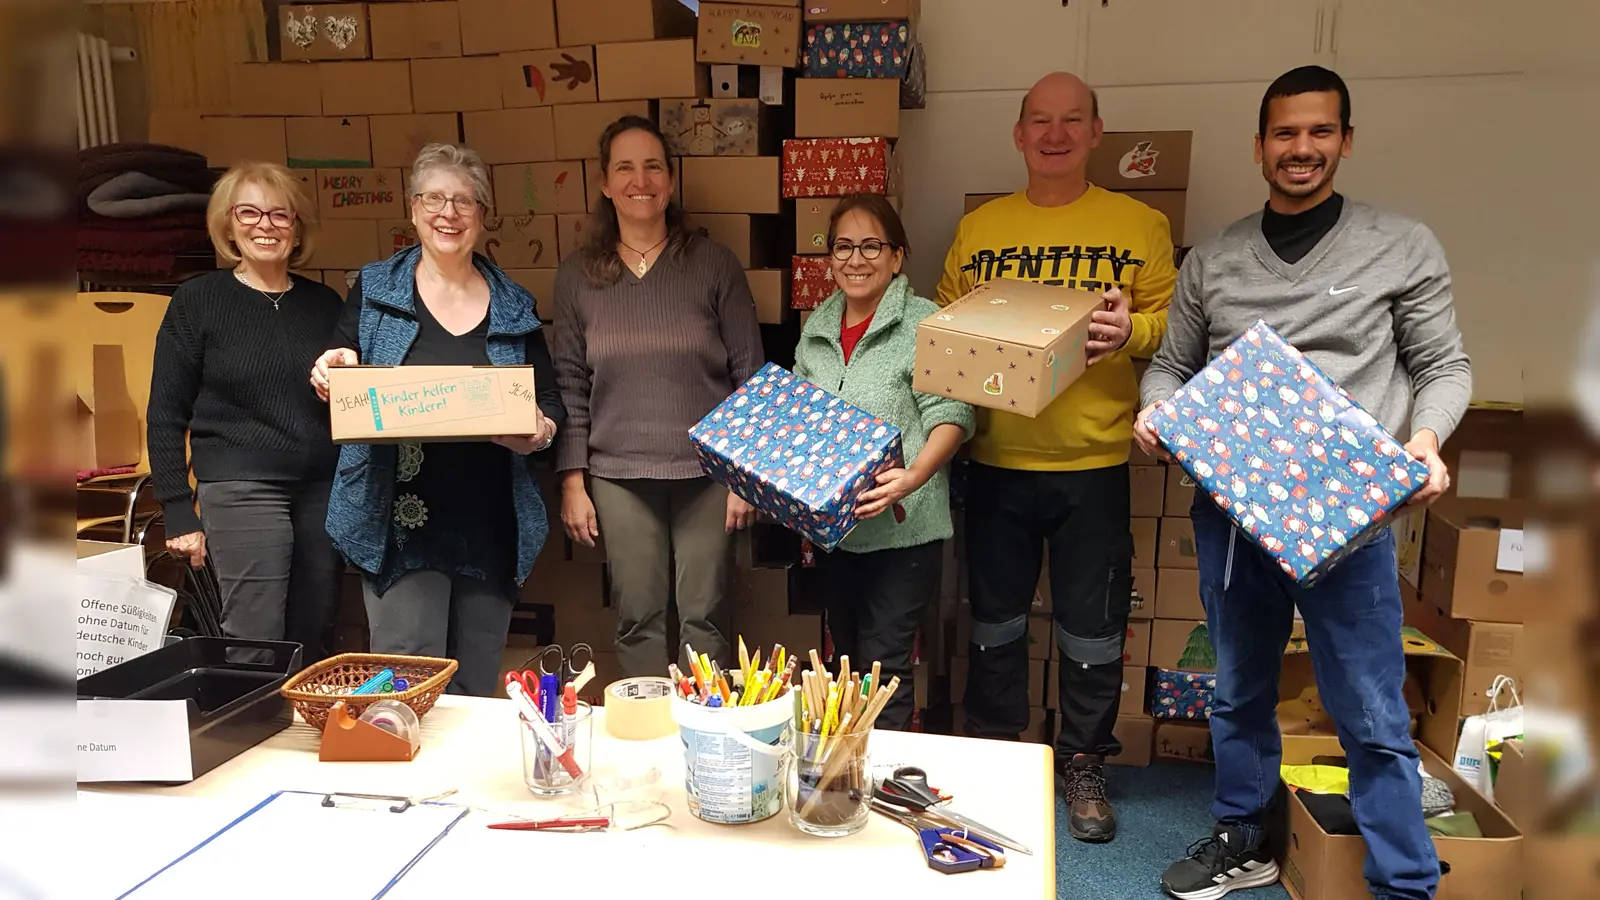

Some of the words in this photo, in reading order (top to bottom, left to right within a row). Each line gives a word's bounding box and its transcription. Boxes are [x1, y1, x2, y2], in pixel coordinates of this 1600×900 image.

[709, 8, 740, 18] HAPPY
[323, 174, 363, 190] MERRY
[971, 245, 1131, 283] IDENTITY
[381, 389, 419, 405] Kinder
[423, 383, 456, 397] helfen
[399, 400, 447, 417] Kindern!
[81, 598, 118, 612] Offene
[78, 615, 107, 626] ohne
[110, 618, 140, 632] Datum
[140, 624, 149, 636] für
[77, 630, 125, 645] deutsche
[127, 636, 148, 652] Kinder
[77, 651, 104, 662] noch
[106, 655, 124, 665] gut
[89, 742, 117, 752] Datum
